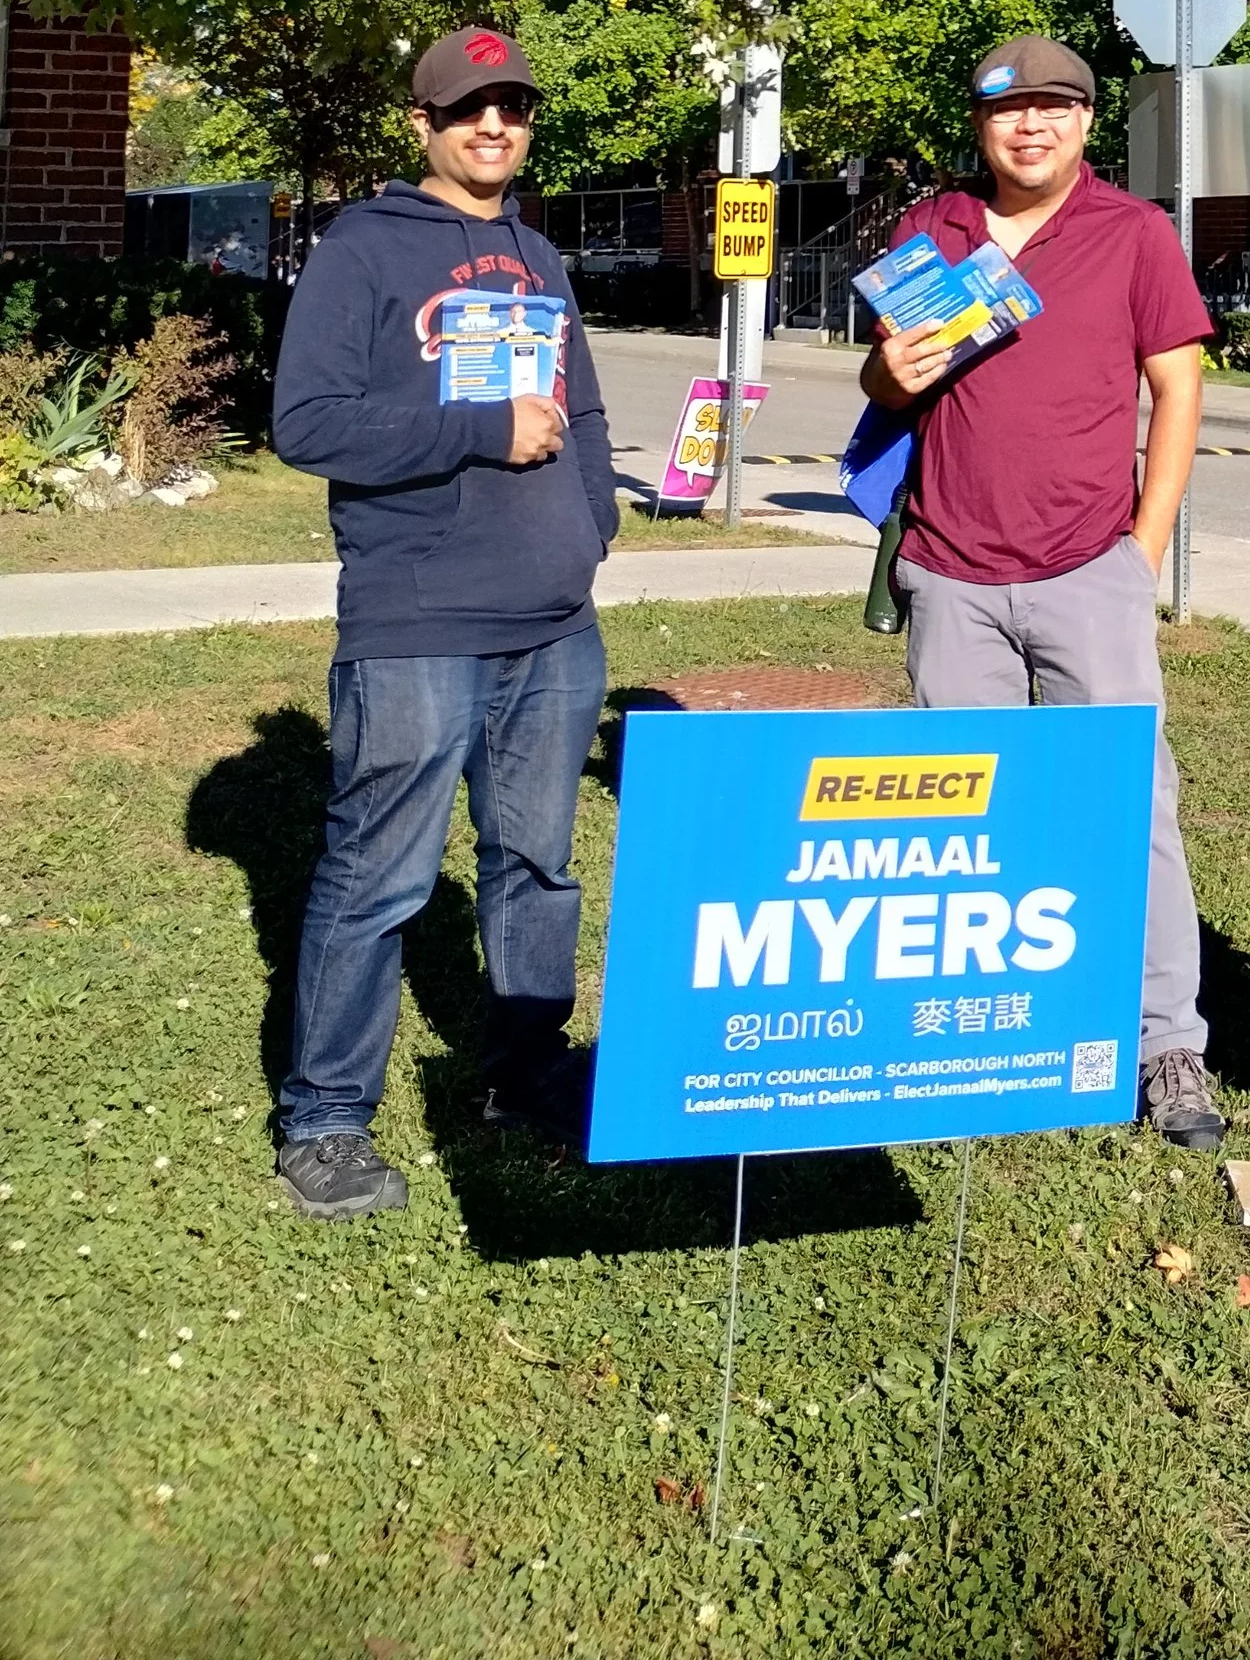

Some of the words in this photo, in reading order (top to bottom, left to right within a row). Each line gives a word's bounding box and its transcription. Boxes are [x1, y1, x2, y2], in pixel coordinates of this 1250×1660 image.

[723, 201, 768, 223] SPEED
[723, 235, 766, 257] BUMP
[815, 771, 985, 803] RE-ELECT
[786, 834, 1000, 883] JAMAAL
[692, 886, 1078, 989] MYERS
[725, 998, 864, 1051] ஜமால்
[912, 992, 1033, 1037] 麥智謀
[684, 1075, 721, 1090] FOR
[724, 1071, 763, 1088] CITY
[766, 1065, 874, 1085] COUNCILLOR
[885, 1056, 1008, 1078] SCARBOROUGH
[1012, 1051, 1066, 1068] NORTH
[684, 1093, 774, 1113] Leadership
[779, 1090, 815, 1107] That
[818, 1088, 881, 1105] Delivers
[894, 1074, 1062, 1101] ElectJamaalMyers.com
